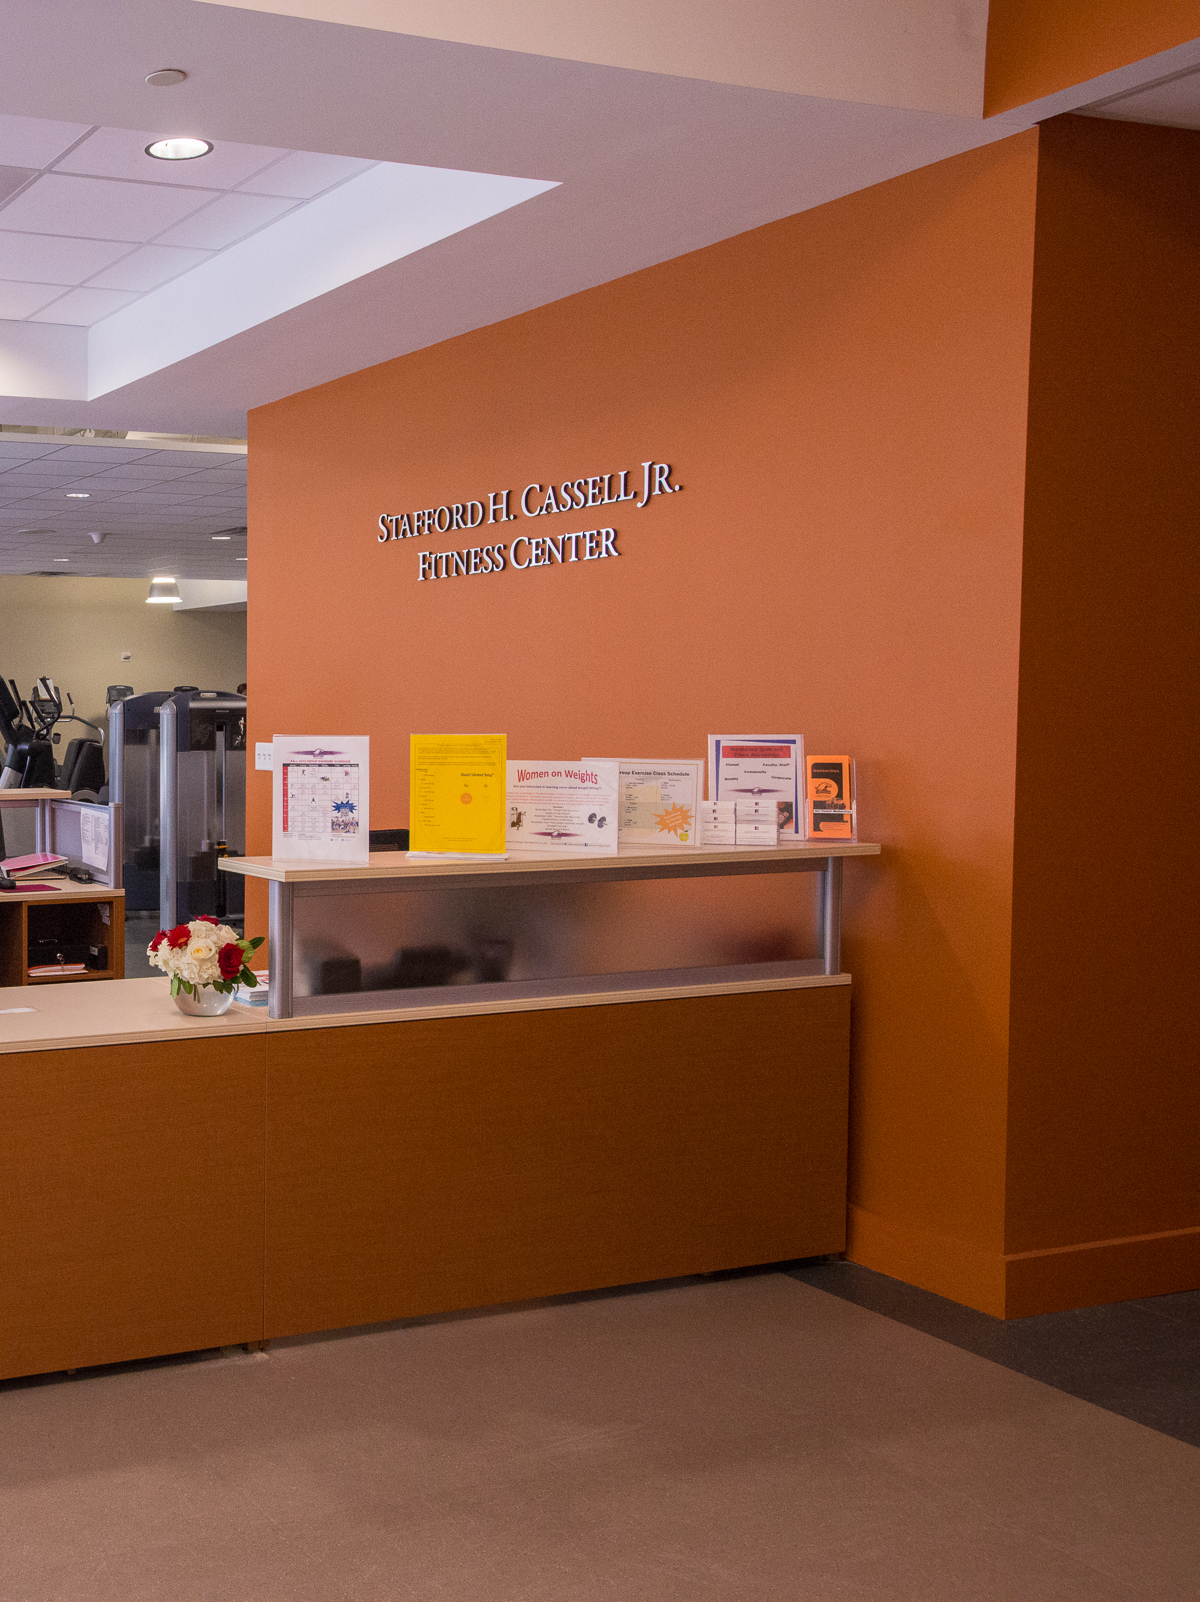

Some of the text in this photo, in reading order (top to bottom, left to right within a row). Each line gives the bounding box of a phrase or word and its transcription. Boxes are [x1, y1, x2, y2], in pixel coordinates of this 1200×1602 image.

[377, 500, 484, 543] STAFFORD
[487, 490, 516, 524] H.
[520, 470, 636, 518] CASSELL
[416, 527, 620, 581] FITNESS CENTER
[517, 769, 598, 785] Women on Weights
